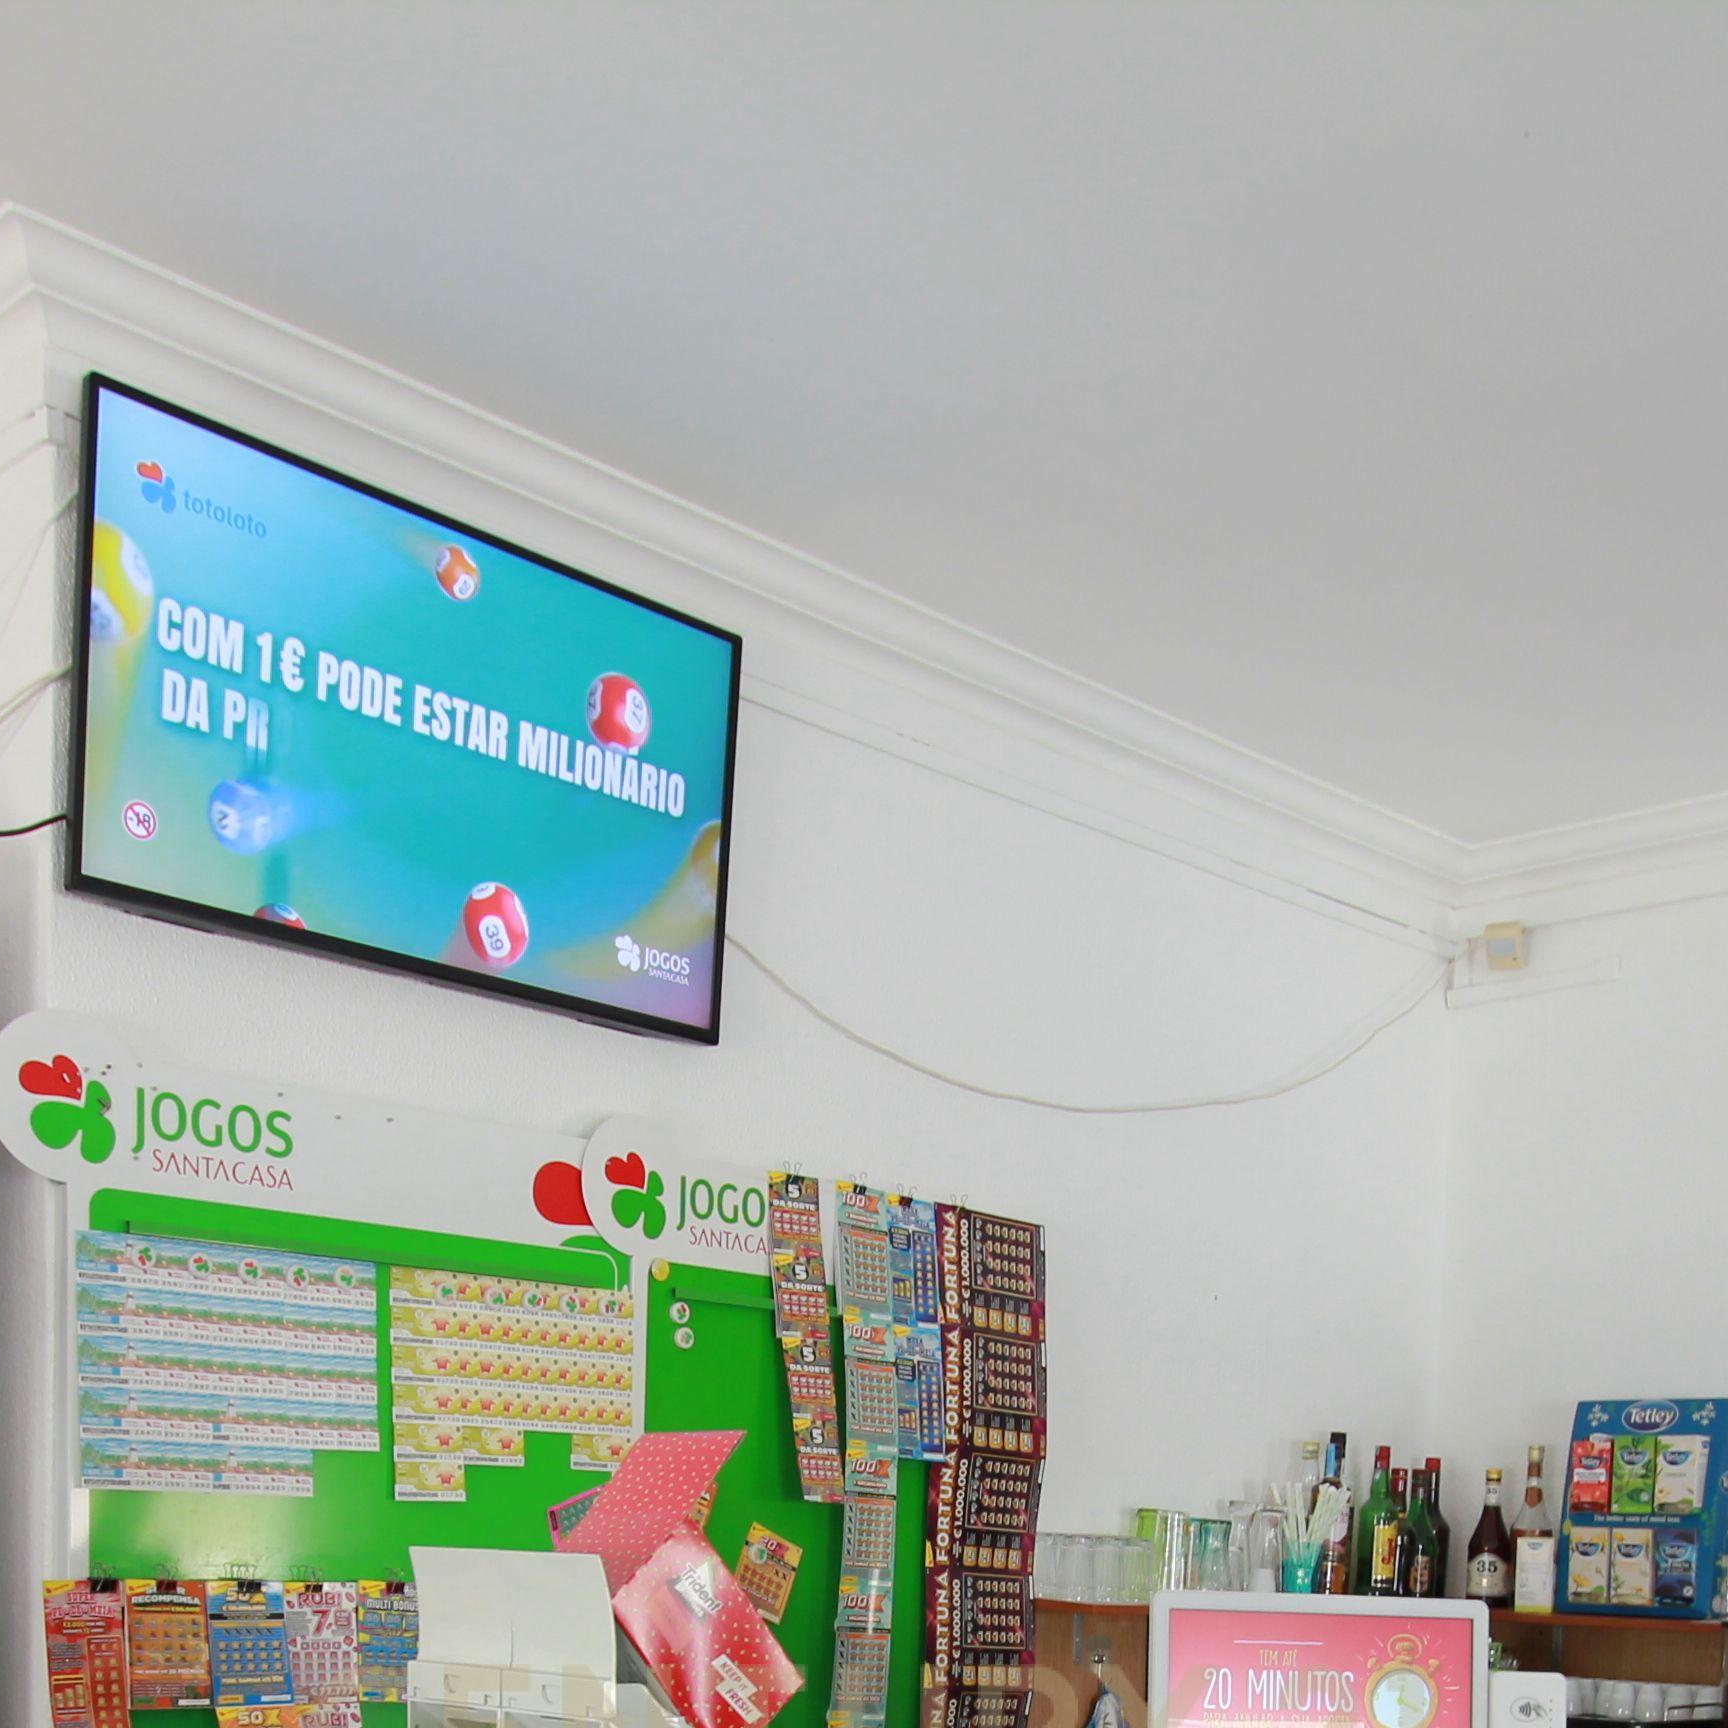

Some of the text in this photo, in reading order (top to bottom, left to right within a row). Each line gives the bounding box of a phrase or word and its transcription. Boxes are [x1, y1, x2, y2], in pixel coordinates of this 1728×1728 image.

[183, 489, 267, 539] totoloto
[157, 598, 243, 674] COM
[317, 650, 402, 726] PODE
[412, 683, 509, 762] ESTAR
[517, 728, 686, 818] MILIONÁRIO
[160, 667, 210, 735] DA
[642, 947, 691, 977] JOGOS
[131, 1086, 294, 1159] JOGOS
[151, 1148, 295, 1192] SANTACASA
[676, 1176, 769, 1228] JOGO
[688, 1223, 769, 1256] SANTACA
[940, 1211, 960, 1322] FORTUNA
[944, 1326, 961, 1443] FORTUNA
[1629, 1407, 1674, 1427] Tetley
[680, 1563, 723, 1613] Trident
[1476, 1558, 1499, 1575] 35
[719, 1661, 742, 1687] KEEP
[1203, 1667, 1355, 1713] 20 MINUTOS
[723, 1687, 753, 1716] FRESH
